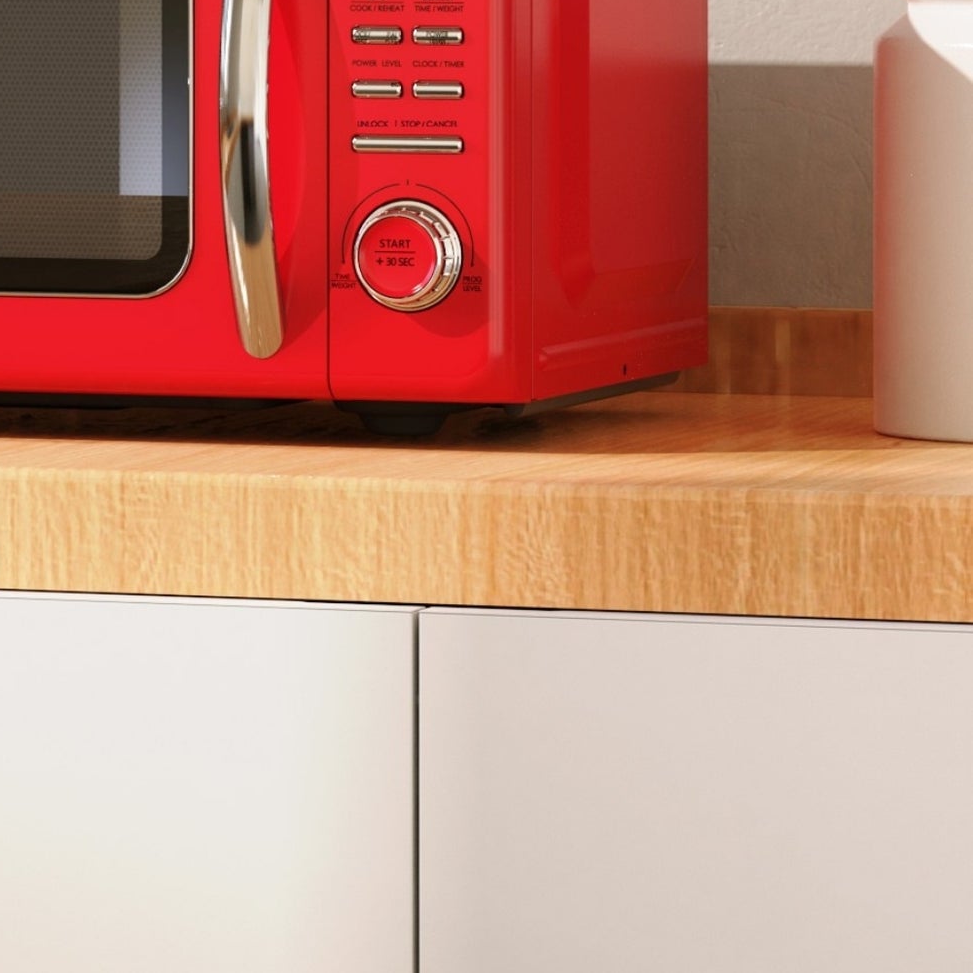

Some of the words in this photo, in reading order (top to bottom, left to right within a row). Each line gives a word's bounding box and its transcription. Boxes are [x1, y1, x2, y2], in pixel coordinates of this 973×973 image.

[412, 60, 438, 68] CLOCK
[357, 120, 388, 128] UNLOCK
[379, 239, 411, 249] START
[398, 257, 415, 267] SEC
